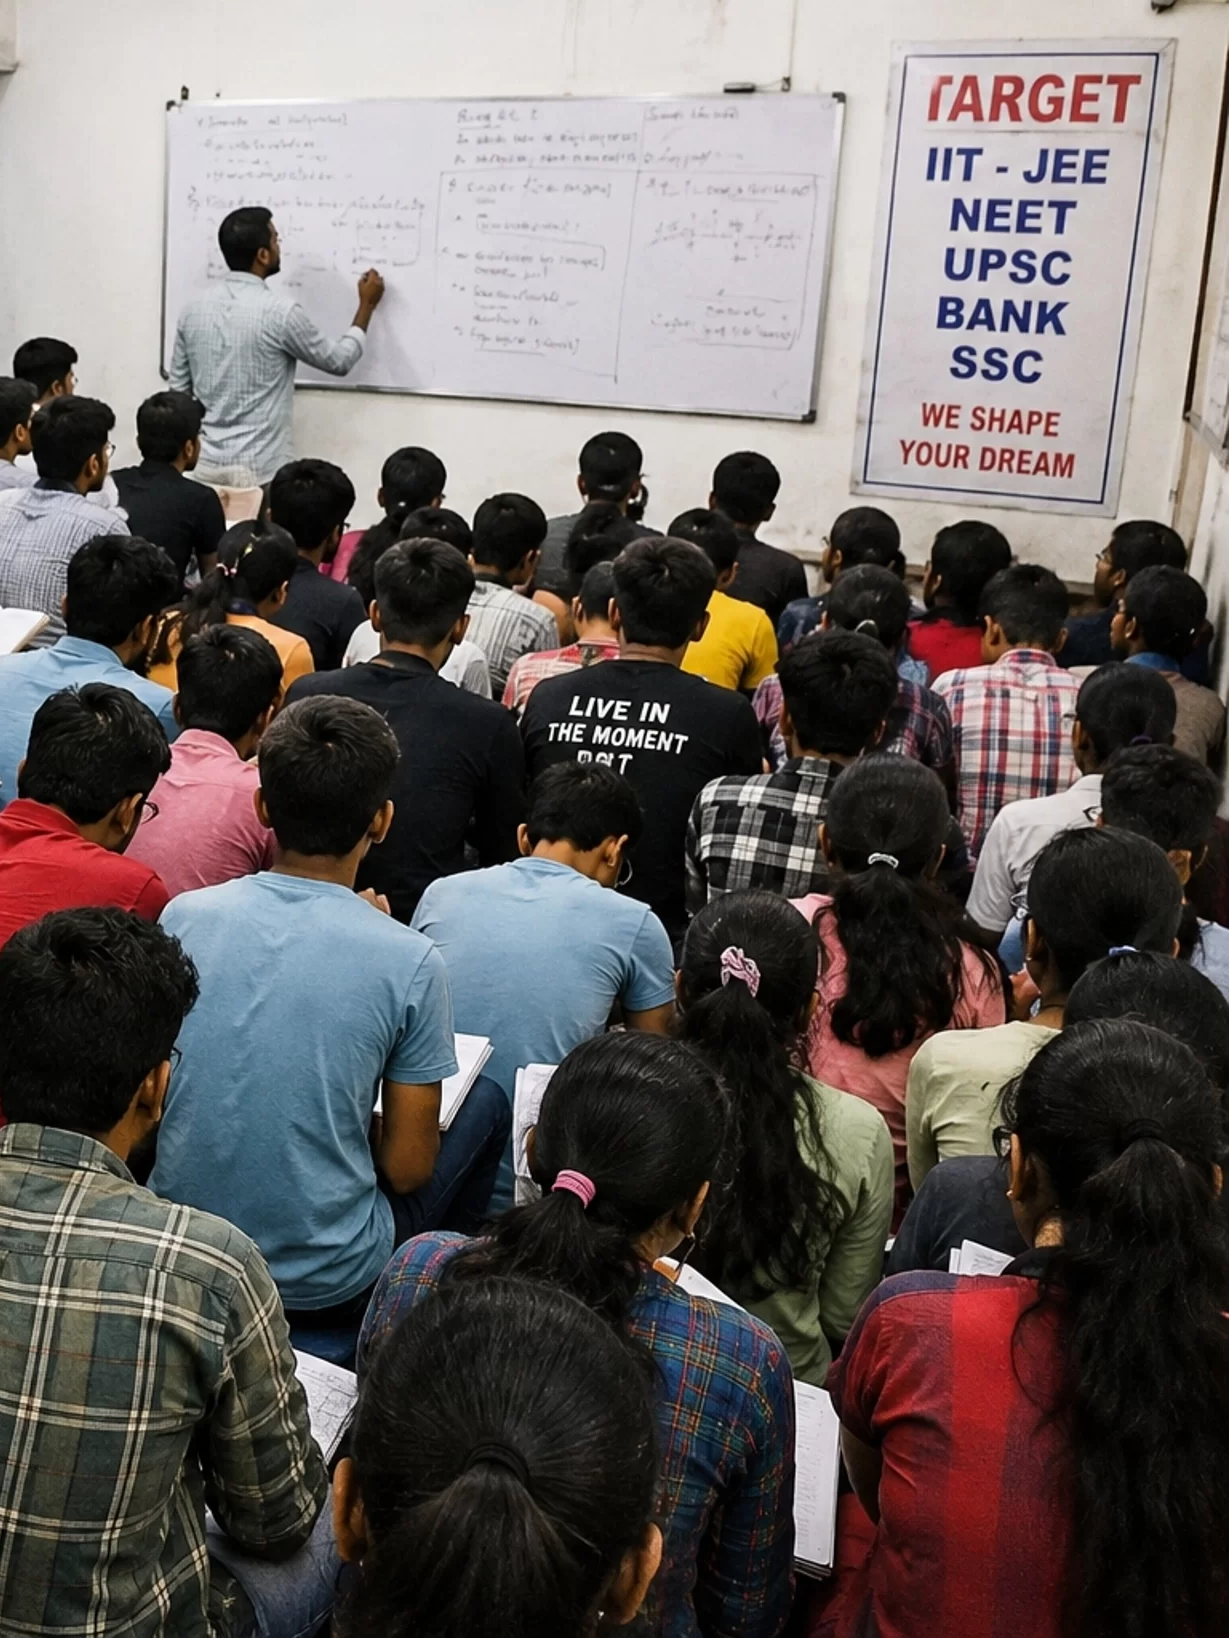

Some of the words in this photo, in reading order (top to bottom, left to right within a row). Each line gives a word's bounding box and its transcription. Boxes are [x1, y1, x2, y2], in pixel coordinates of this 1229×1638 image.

[926, 73, 1143, 124] TARGET
[925, 147, 983, 182] IIT
[1022, 148, 1110, 184] JEE
[949, 198, 1077, 235] NEET
[943, 247, 1072, 286] UPSC
[935, 295, 1069, 336] BANK
[949, 345, 1043, 384] SSC
[921, 402, 962, 430] WE
[969, 405, 1061, 439] SHAPE
[899, 440, 971, 469] YOUR
[979, 446, 1076, 479] DREAM
[568, 695, 632, 721] LIVE
[639, 701, 671, 724] IN
[548, 722, 587, 743] THE
[591, 724, 689, 755] MOMENT
